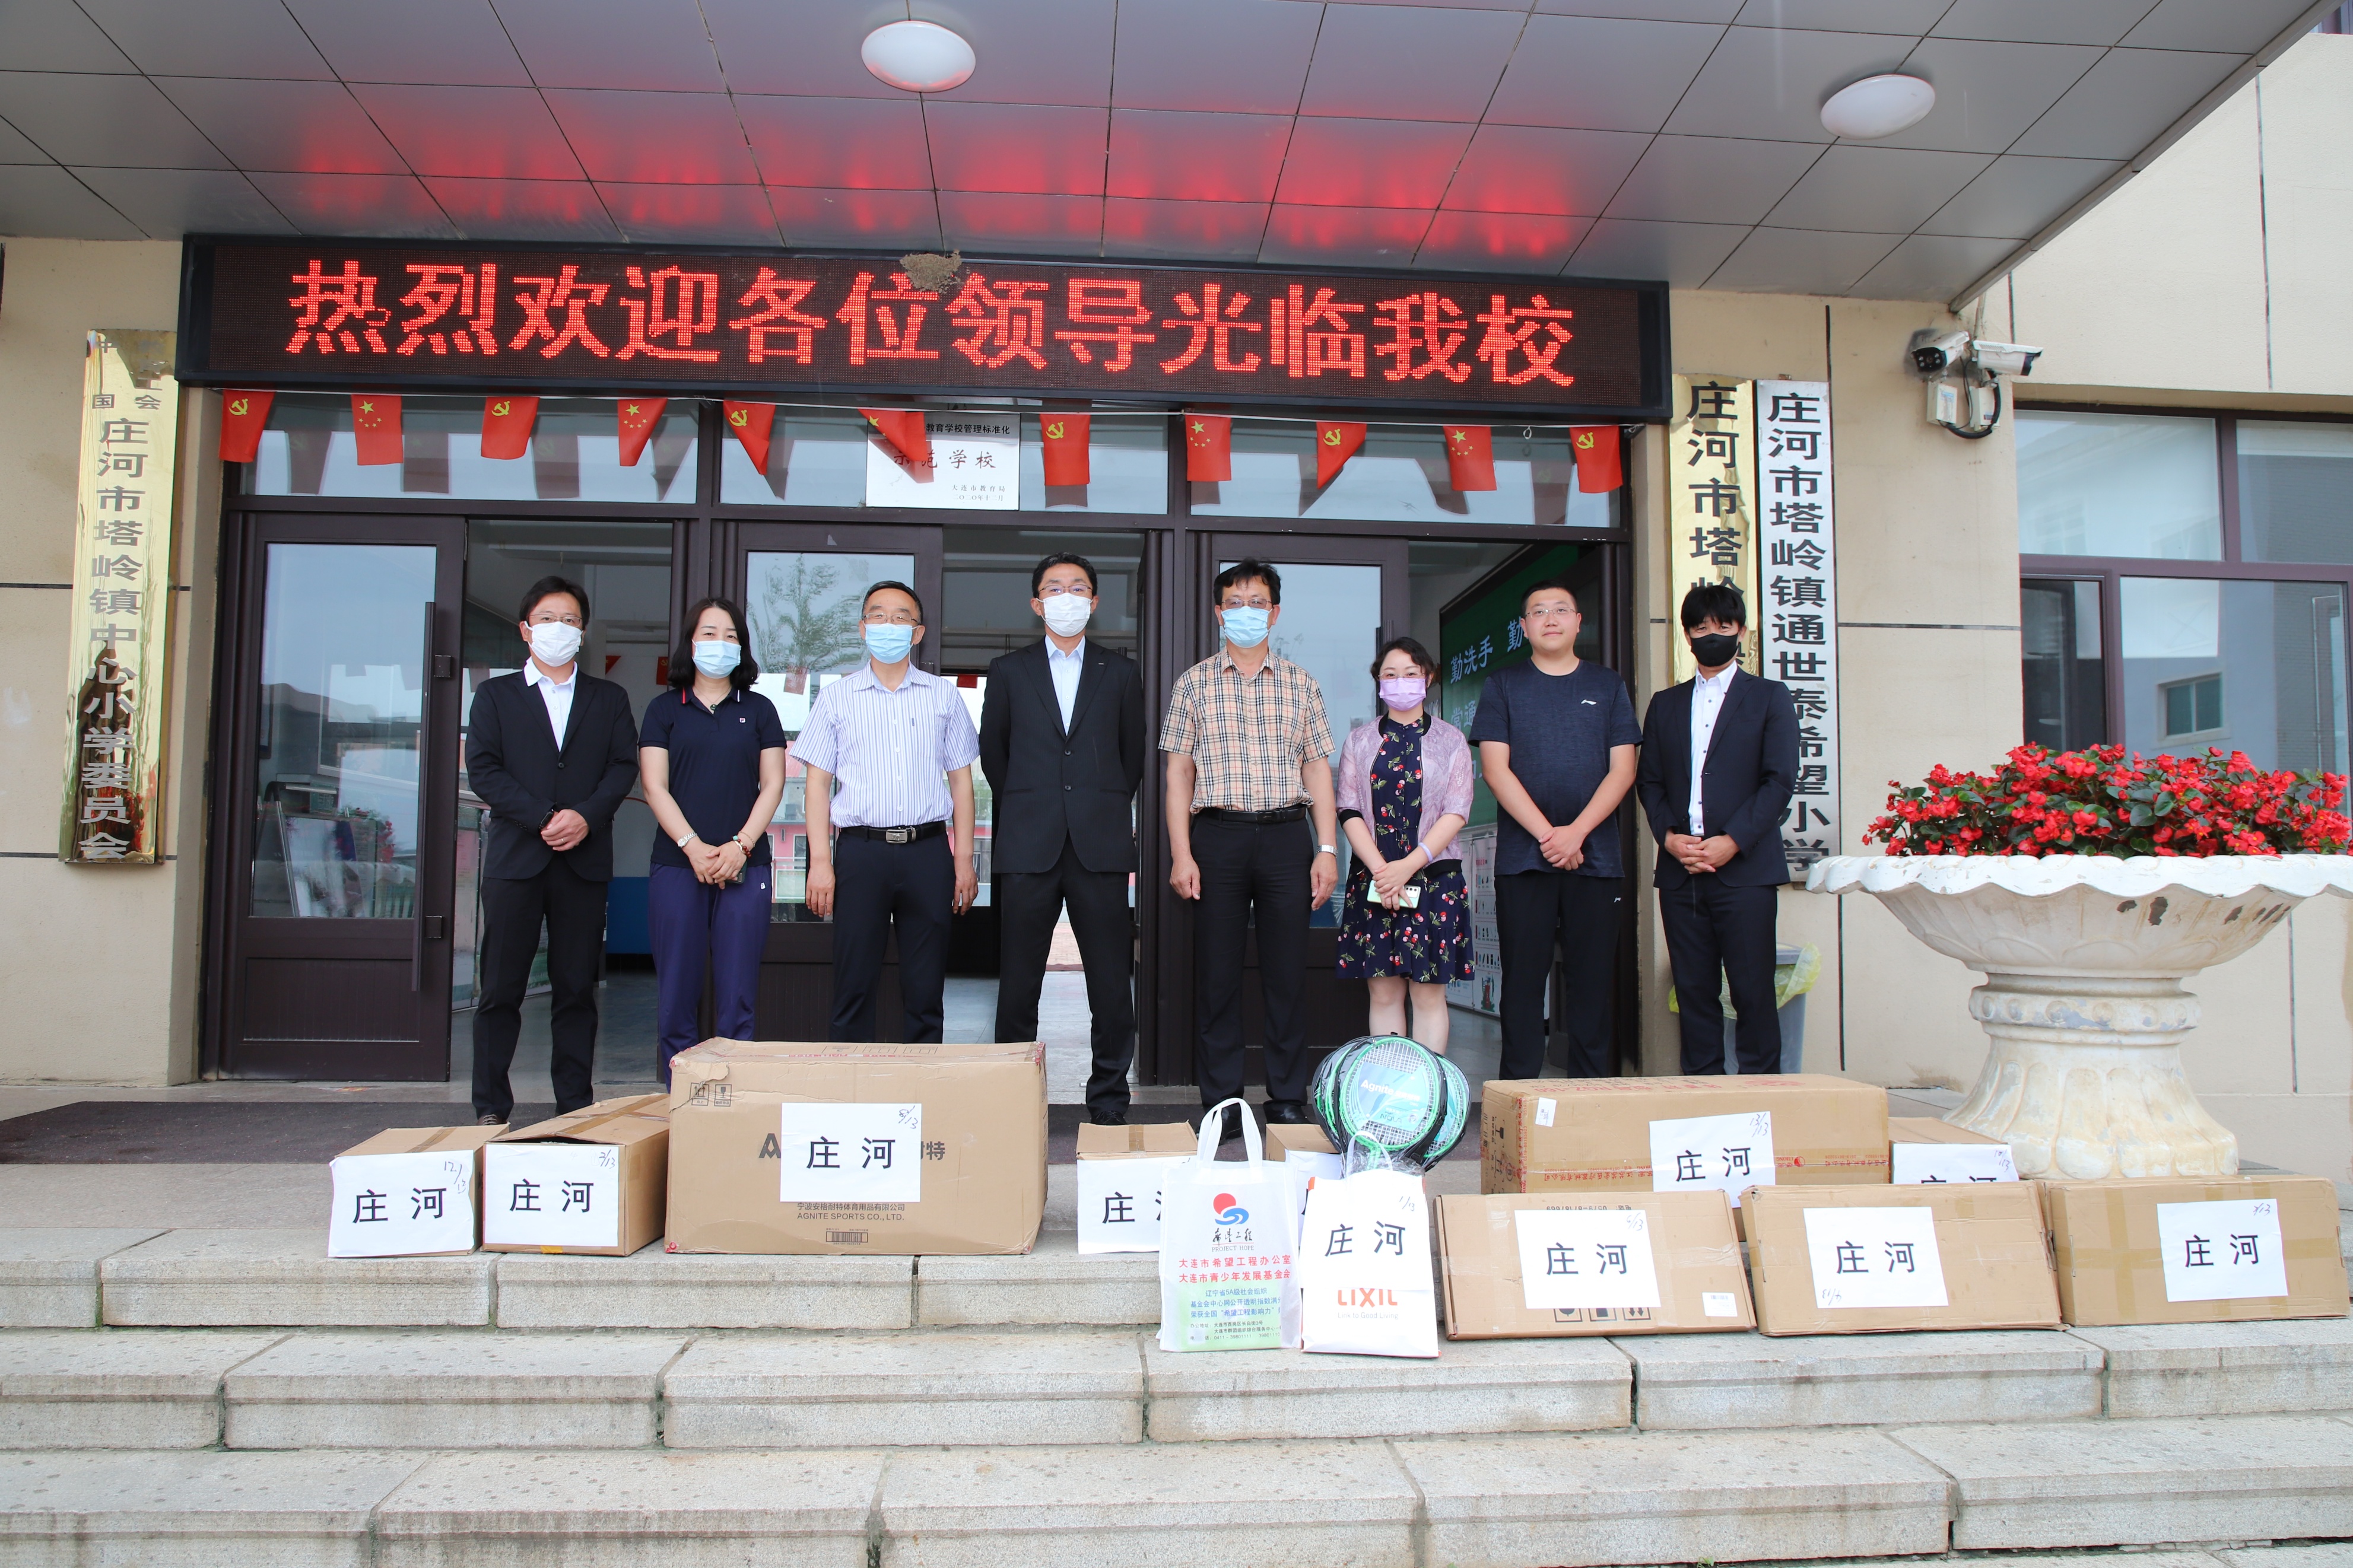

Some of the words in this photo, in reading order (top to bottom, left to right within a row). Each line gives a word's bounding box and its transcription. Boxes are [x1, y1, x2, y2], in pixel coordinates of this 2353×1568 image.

[286, 259, 1574, 386] 热烈欢迎各位领导光临我校
[923, 423, 1011, 435] 教育学校管理标准化
[951, 484, 1005, 492] 大连市教育局
[78, 417, 150, 860] 庄河市塔岭镇中心小学委员会
[1450, 635, 1494, 685] 勤洗手
[1361, 1079, 1395, 1096] Agnite
[806, 1136, 896, 1169] 庄河
[1675, 1147, 1751, 1182] 庄河
[353, 1187, 447, 1223] 庄河
[510, 1178, 594, 1213] 庄河
[797, 1202, 905, 1211] 宁波安格耐特体育用品有限公司
[1325, 1220, 1406, 1257] 庄河
[2185, 1234, 2259, 1268] 庄河
[1179, 1254, 1291, 1268] 大连市希望工程办公室
[1547, 1242, 1627, 1276] 庄河
[1836, 1241, 1915, 1274] 庄河
[1179, 1268, 1291, 1283] 大连市青少年发展基金会
[1205, 1287, 1268, 1297] 辽宁省5A级社会组织
[1338, 1287, 1398, 1308] LIXIL
[1214, 1325, 1281, 1334] 大连市群团组织综合服务中心一
[1379, 1312, 1399, 1320] Living
